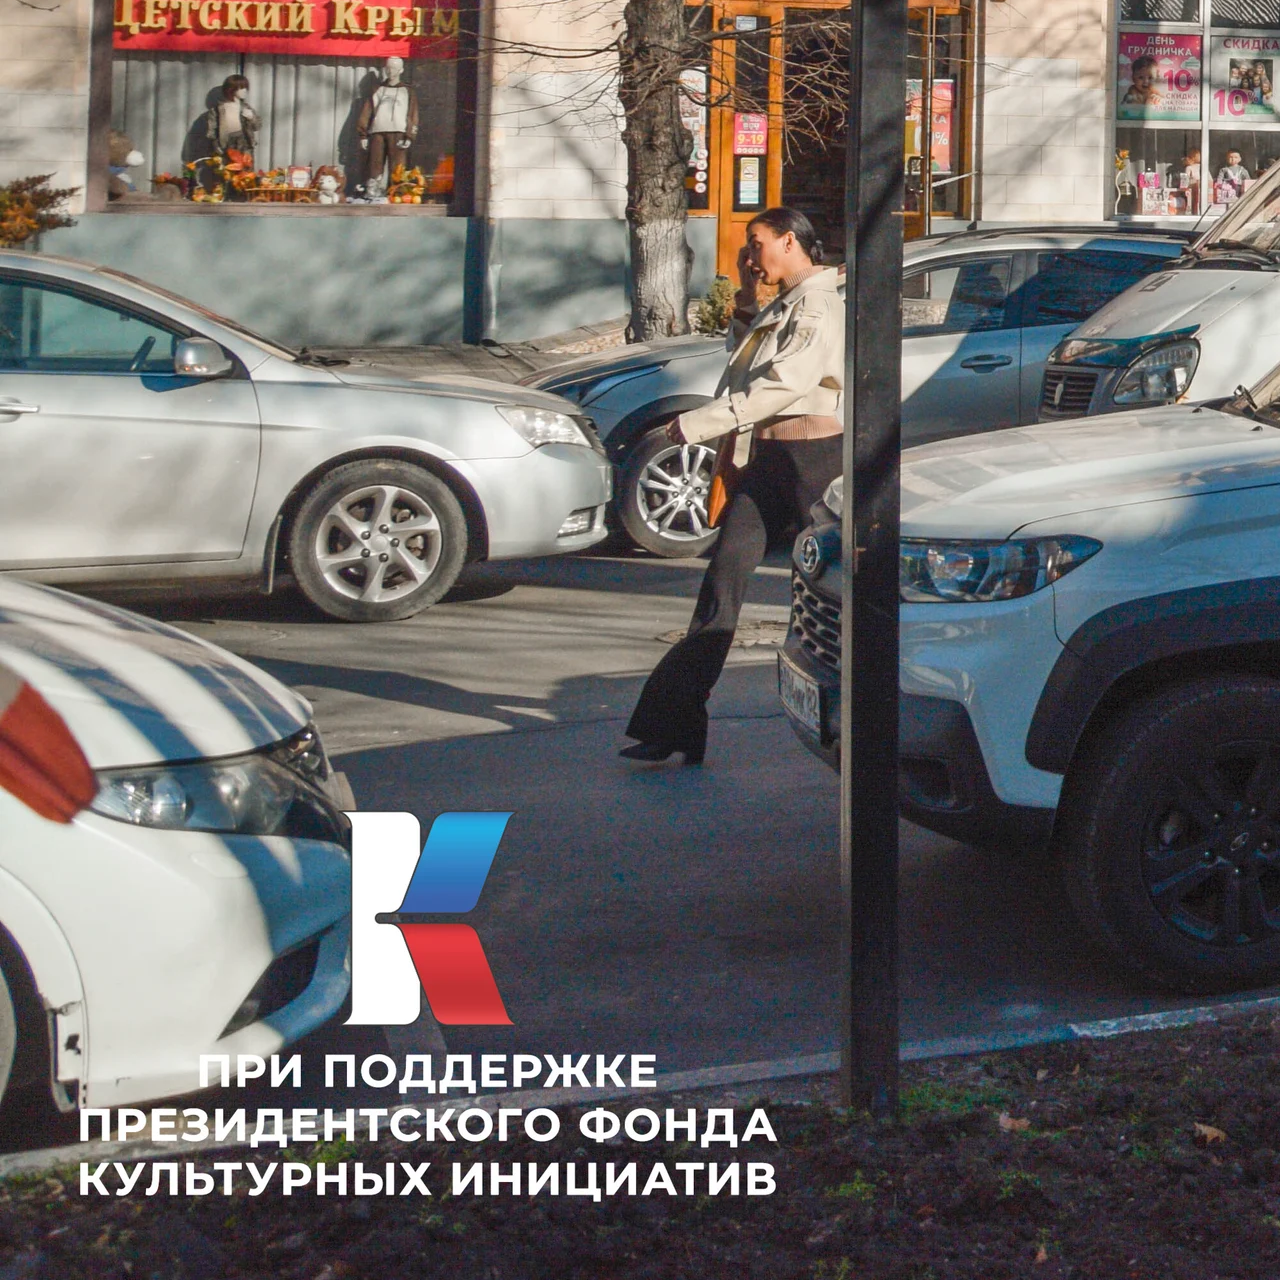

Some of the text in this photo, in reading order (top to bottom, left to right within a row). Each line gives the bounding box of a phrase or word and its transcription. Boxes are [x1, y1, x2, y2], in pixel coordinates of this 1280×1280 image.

[1146, 36, 1175, 46] ДЕНЬ
[1223, 38, 1280, 51] СКИДКА
[1128, 45, 1192, 57] ГРУДНИЧКА
[1163, 69, 1200, 92] 10%
[1165, 92, 1198, 100] СКИДКА
[1213, 88, 1260, 117] 10%
[737, 133, 765, 145] 9-19
